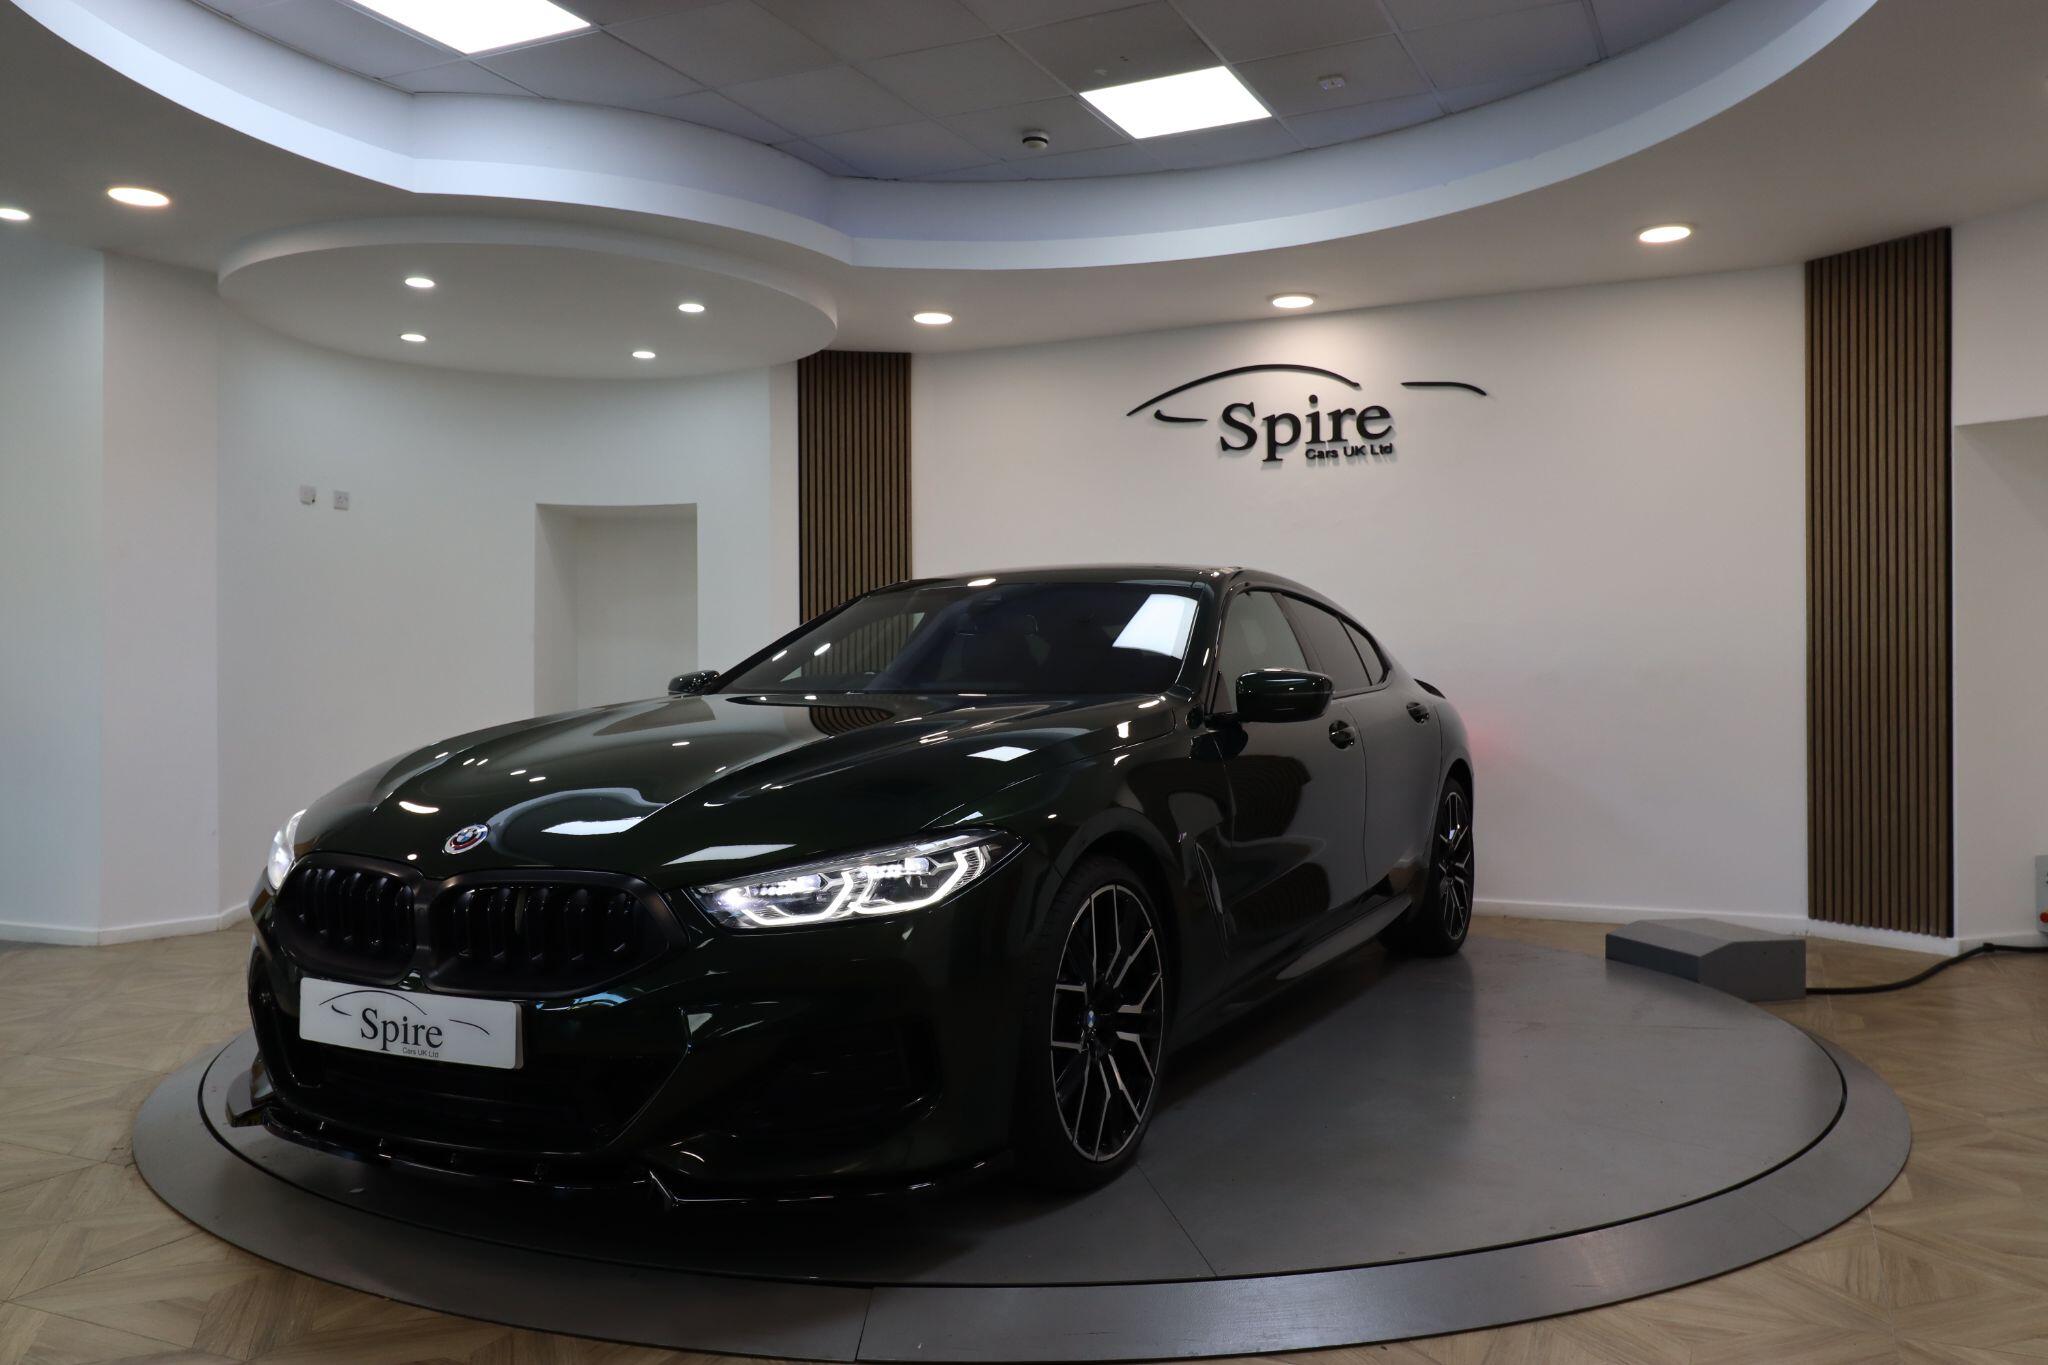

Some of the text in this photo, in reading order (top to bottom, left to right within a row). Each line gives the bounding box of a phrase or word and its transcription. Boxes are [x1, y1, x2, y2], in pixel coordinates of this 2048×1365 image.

[1219, 394, 1393, 463] Spire
[1305, 442, 1394, 460] Cars UK Ltd
[360, 1007, 443, 1051] Spire
[418, 1048, 427, 1056] UK
